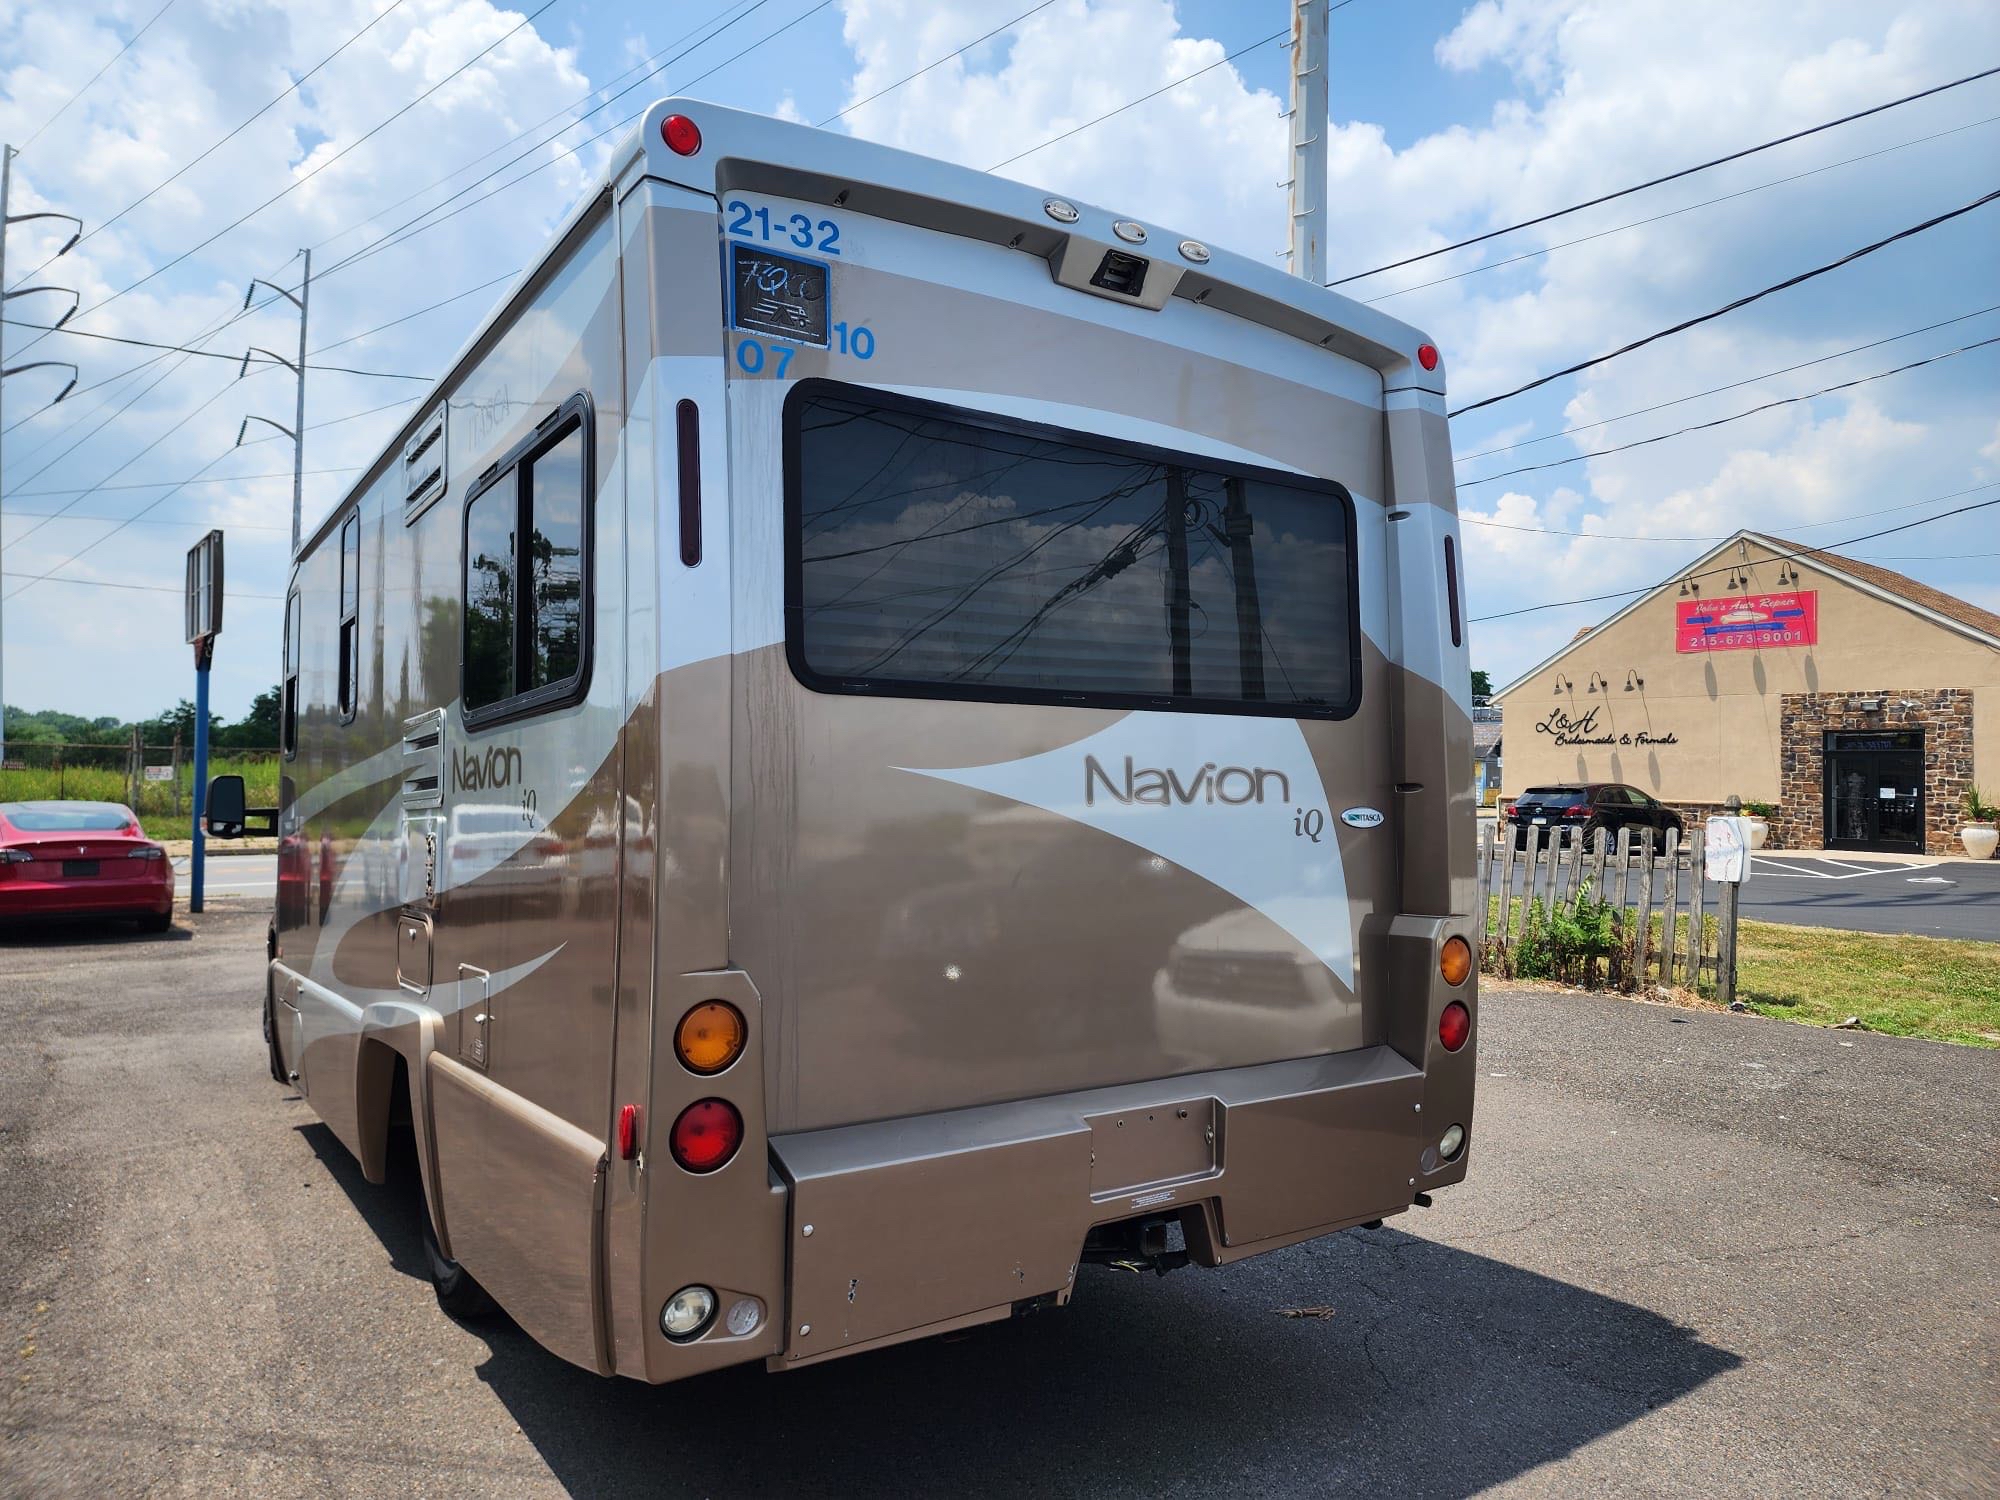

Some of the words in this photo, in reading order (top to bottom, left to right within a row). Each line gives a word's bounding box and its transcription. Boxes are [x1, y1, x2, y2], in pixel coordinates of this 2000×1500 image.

[728, 201, 841, 255] 21-32
[736, 339, 796, 380] 07
[834, 321, 875, 360] 10
[1760, 598, 1796, 609] Repair
[1690, 631, 1802, 647] 215-673-9001
[1554, 732, 1617, 746] Bridesmaids
[1620, 733, 1632, 745] &
[1635, 731, 1679, 748] Formals
[452, 745, 522, 795] Navion
[1084, 753, 1290, 808] Navion
[522, 788, 537, 829] iQ
[1293, 808, 1324, 843] iQ
